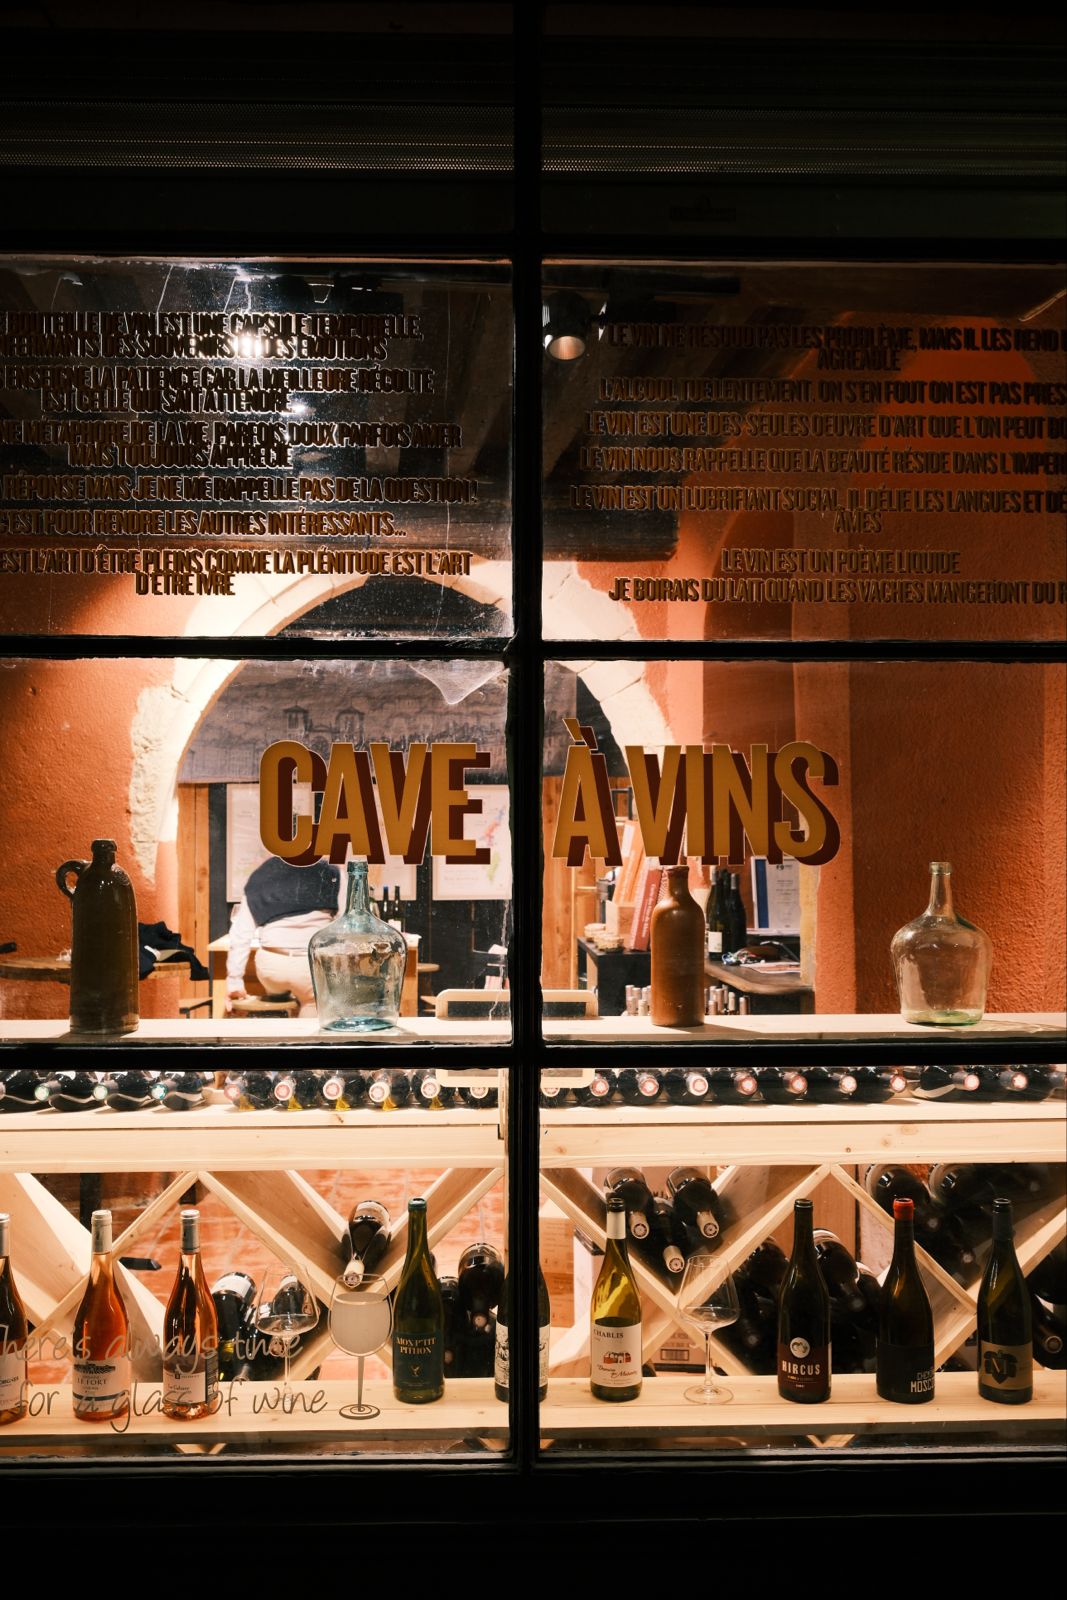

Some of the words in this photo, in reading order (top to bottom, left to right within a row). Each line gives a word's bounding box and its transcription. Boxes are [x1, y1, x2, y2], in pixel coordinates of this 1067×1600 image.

[192, 313, 228, 335] UNE
[229, 313, 309, 336] CAPSULE
[981, 327, 1012, 351] LES
[202, 366, 237, 389] CAR
[239, 366, 261, 389] LA
[263, 367, 358, 391] MEILLEURE
[818, 379, 843, 403] ON
[884, 380, 927, 404] FOUT
[928, 381, 954, 404] ON
[955, 381, 987, 405] EST
[988, 381, 1021, 405] PAS
[288, 422, 337, 446] DOUX
[338, 423, 411, 447] PARFOIS
[586, 411, 604, 436] LE
[604, 411, 636, 436] VIN
[638, 411, 669, 436] EST
[670, 411, 706, 436] UNE
[707, 411, 742, 436] DES
[746, 412, 809, 437] SEULES
[811, 413, 876, 438] OEUVRE
[928, 415, 963, 439] QUE
[1003, 416, 1046, 439] PEUT
[580, 447, 600, 472] LE
[600, 447, 632, 472] VIN
[633, 447, 682, 472] NOUS
[683, 447, 766, 472] RAPPELLE
[767, 449, 801, 473] QUE
[802, 449, 826, 473] LA
[952, 451, 998, 475] DANS
[4, 469, 85, 500] RÉPONSE
[86, 475, 131, 500] MAIS
[132, 475, 156, 500] JE
[157, 475, 182, 500] NE
[183, 475, 212, 500] ME
[213, 475, 299, 500] RAPPELLE
[300, 477, 334, 501] PAS
[335, 477, 360, 501] DE
[361, 478, 383, 502] LA
[569, 484, 592, 510] LE
[592, 484, 623, 510] VIN
[624, 484, 656, 510] EST
[656, 484, 683, 510] UN
[685, 486, 781, 511] LUBRIFIANT
[913, 488, 944, 512] LES
[946, 489, 1021, 513] LANGUES
[1023, 490, 1045, 514] ET
[44, 509, 93, 534] POUR
[94, 509, 164, 534] RENDRE
[165, 509, 198, 534] LES
[199, 509, 266, 534] AUTRES
[143, 550, 203, 574] PLEINS
[204, 550, 272, 574] COMME
[273, 550, 296, 574] LA
[297, 546, 390, 575] PLÉNITUDE
[392, 551, 424, 575] EST
[426, 551, 473, 575] L'ART
[721, 548, 743, 573] LE
[743, 548, 774, 573] VIN
[776, 548, 807, 573] EST
[808, 548, 834, 573] UN
[897, 550, 961, 574] LIQUIDE
[196, 572, 236, 596] IVRE
[608, 578, 632, 602] JE
[633, 578, 700, 602] BOIRAIS
[701, 578, 727, 602] DU
[728, 578, 765, 602] LAIT
[766, 579, 824, 603] QUAND
[826, 579, 857, 603] LES
[858, 579, 924, 604] VACHES
[926, 580, 1030, 605] MANGERONT
[1031, 581, 1056, 605] DU
[260, 740, 490, 866] CAVE
[552, 718, 622, 866] À
[625, 741, 839, 866] VINS
[782, 1360, 821, 1376] HIRCUS
[15, 1379, 60, 1417] for
[207, 1376, 239, 1416] of
[253, 1387, 328, 1414] wine
